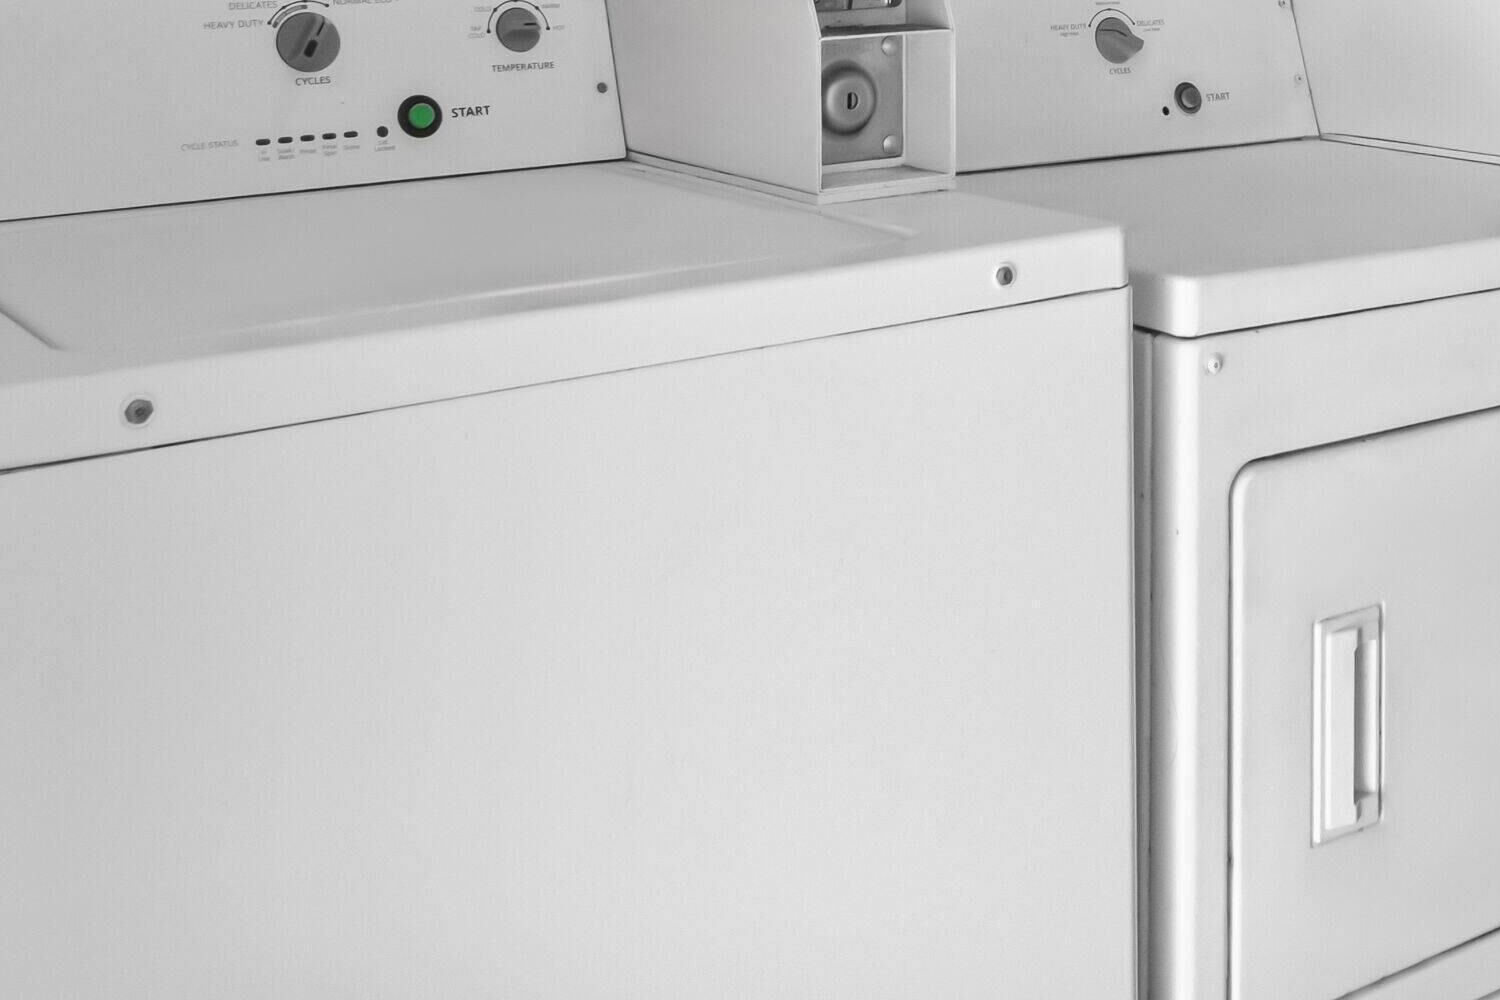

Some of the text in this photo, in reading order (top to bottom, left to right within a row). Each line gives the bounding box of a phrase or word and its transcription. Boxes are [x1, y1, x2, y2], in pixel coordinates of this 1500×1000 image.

[228, 1, 278, 11] DELICATES
[203, 19, 264, 31] HEAVY DUTY
[491, 61, 555, 73] TEMPERATURE
[1109, 67, 1132, 75] CYCLES
[295, 76, 331, 86] CYCLES
[1205, 92, 1231, 102] START
[451, 104, 491, 118] START
